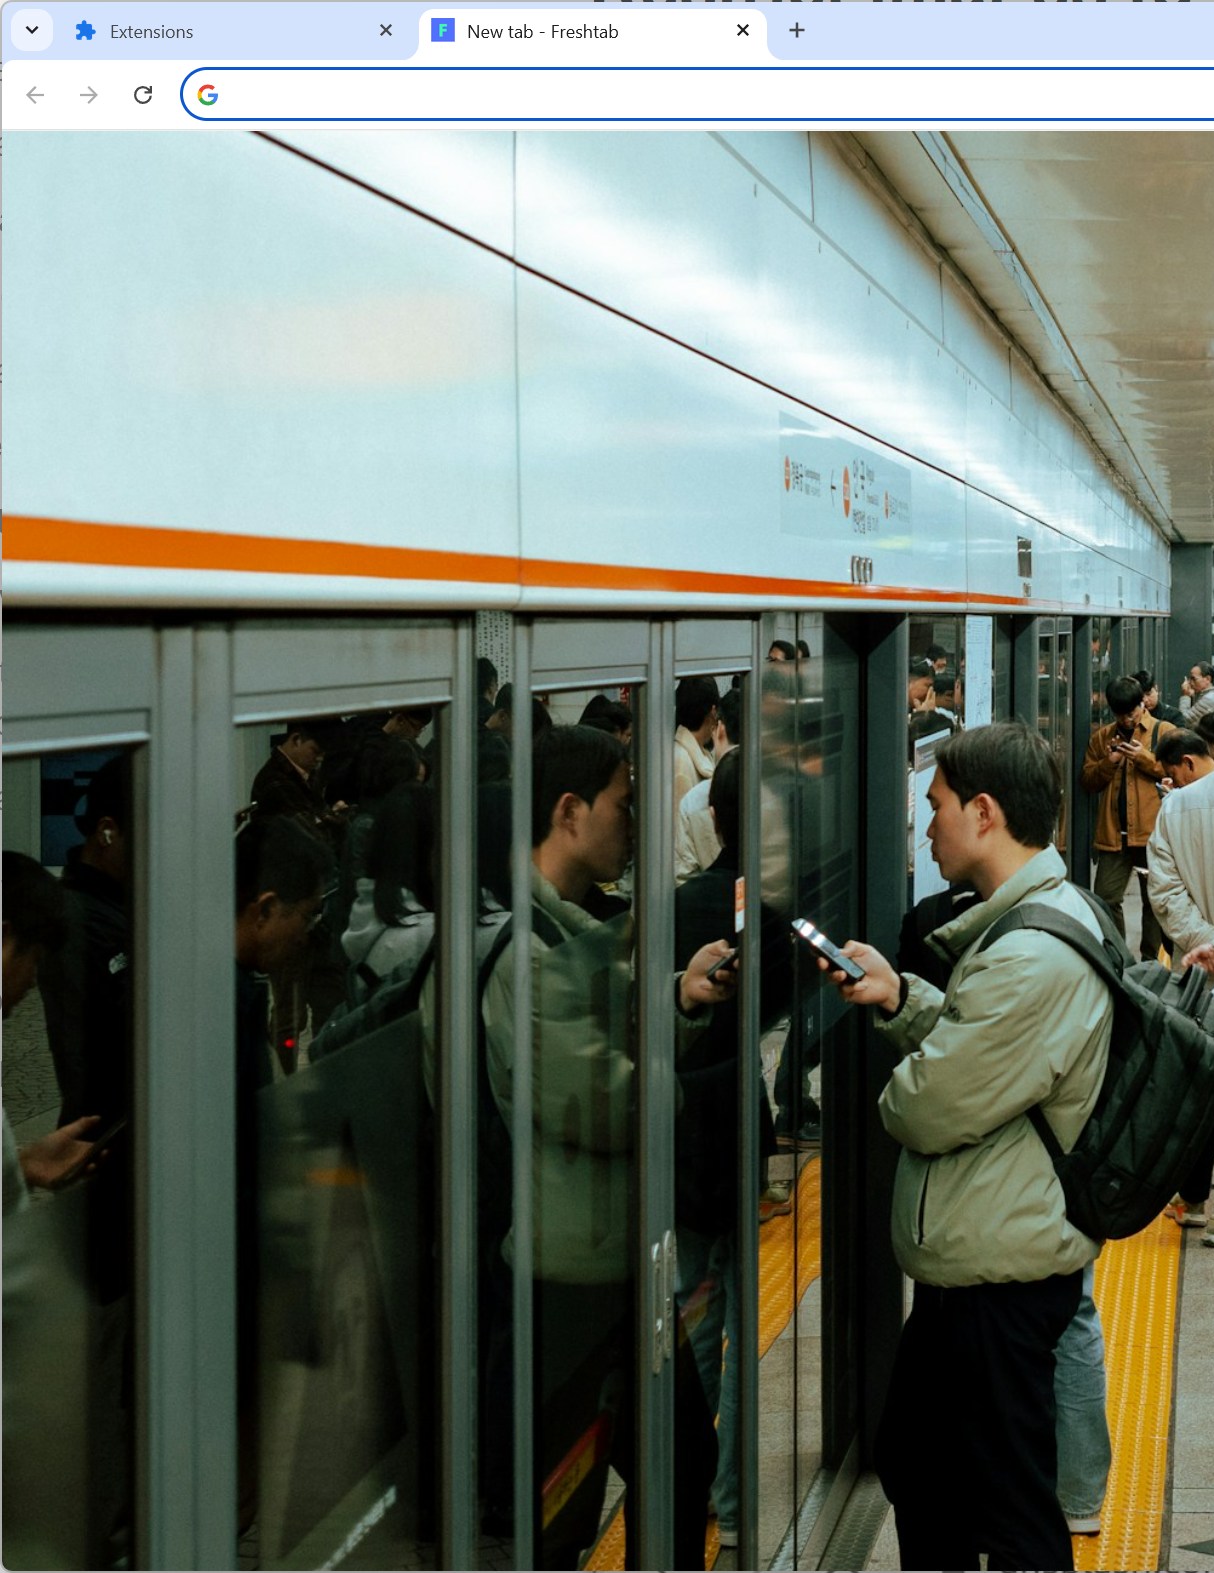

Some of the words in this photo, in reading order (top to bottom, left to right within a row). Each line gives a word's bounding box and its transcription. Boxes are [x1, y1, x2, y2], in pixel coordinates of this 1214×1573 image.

[111, 25, 193, 38] Extensions
[468, 25, 502, 38] New
[508, 24, 533, 38] tab
[552, 24, 618, 38] Freshtab
